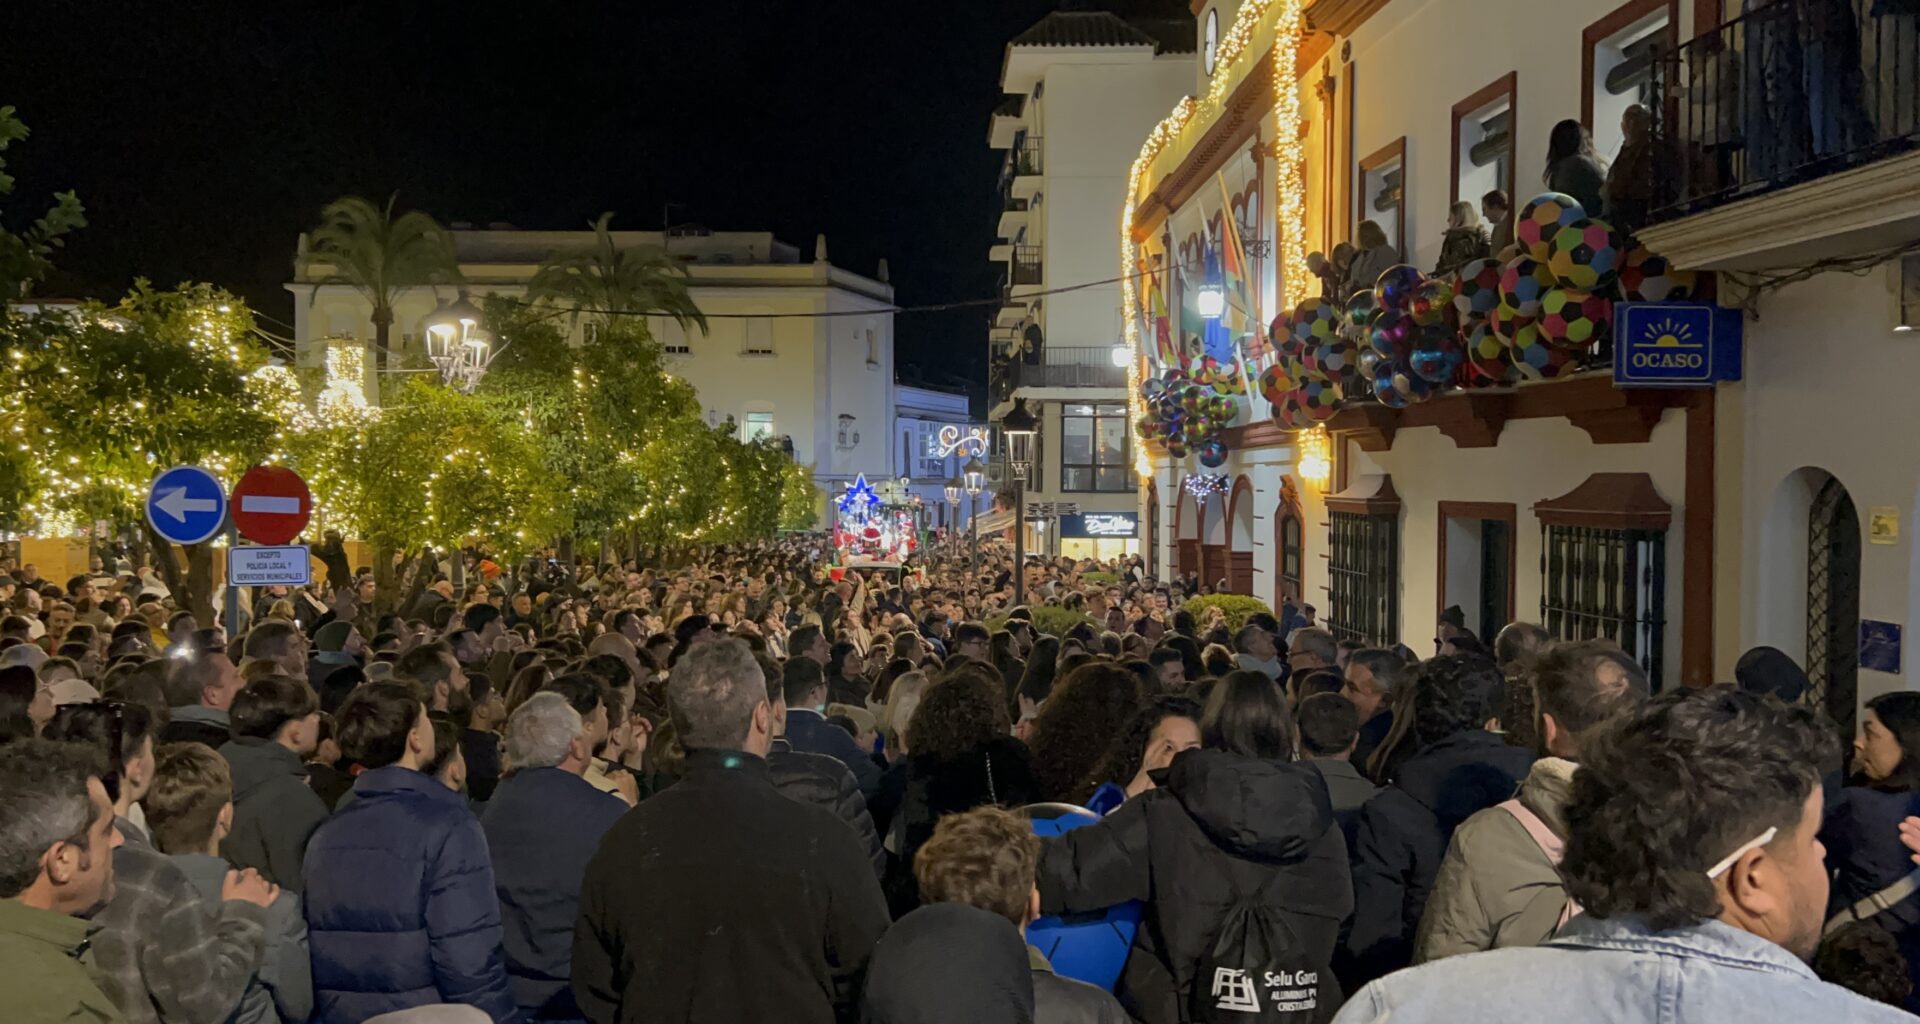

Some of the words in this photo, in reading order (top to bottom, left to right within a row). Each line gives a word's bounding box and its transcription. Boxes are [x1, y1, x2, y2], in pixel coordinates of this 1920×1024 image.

[1632, 352, 1702, 369] OCASO
[256, 551, 281, 559] EXCEPTO
[269, 562, 287, 570] LOCAL
[266, 572, 303, 580] MUNICIPALES
[1264, 970, 1293, 987] Selu
